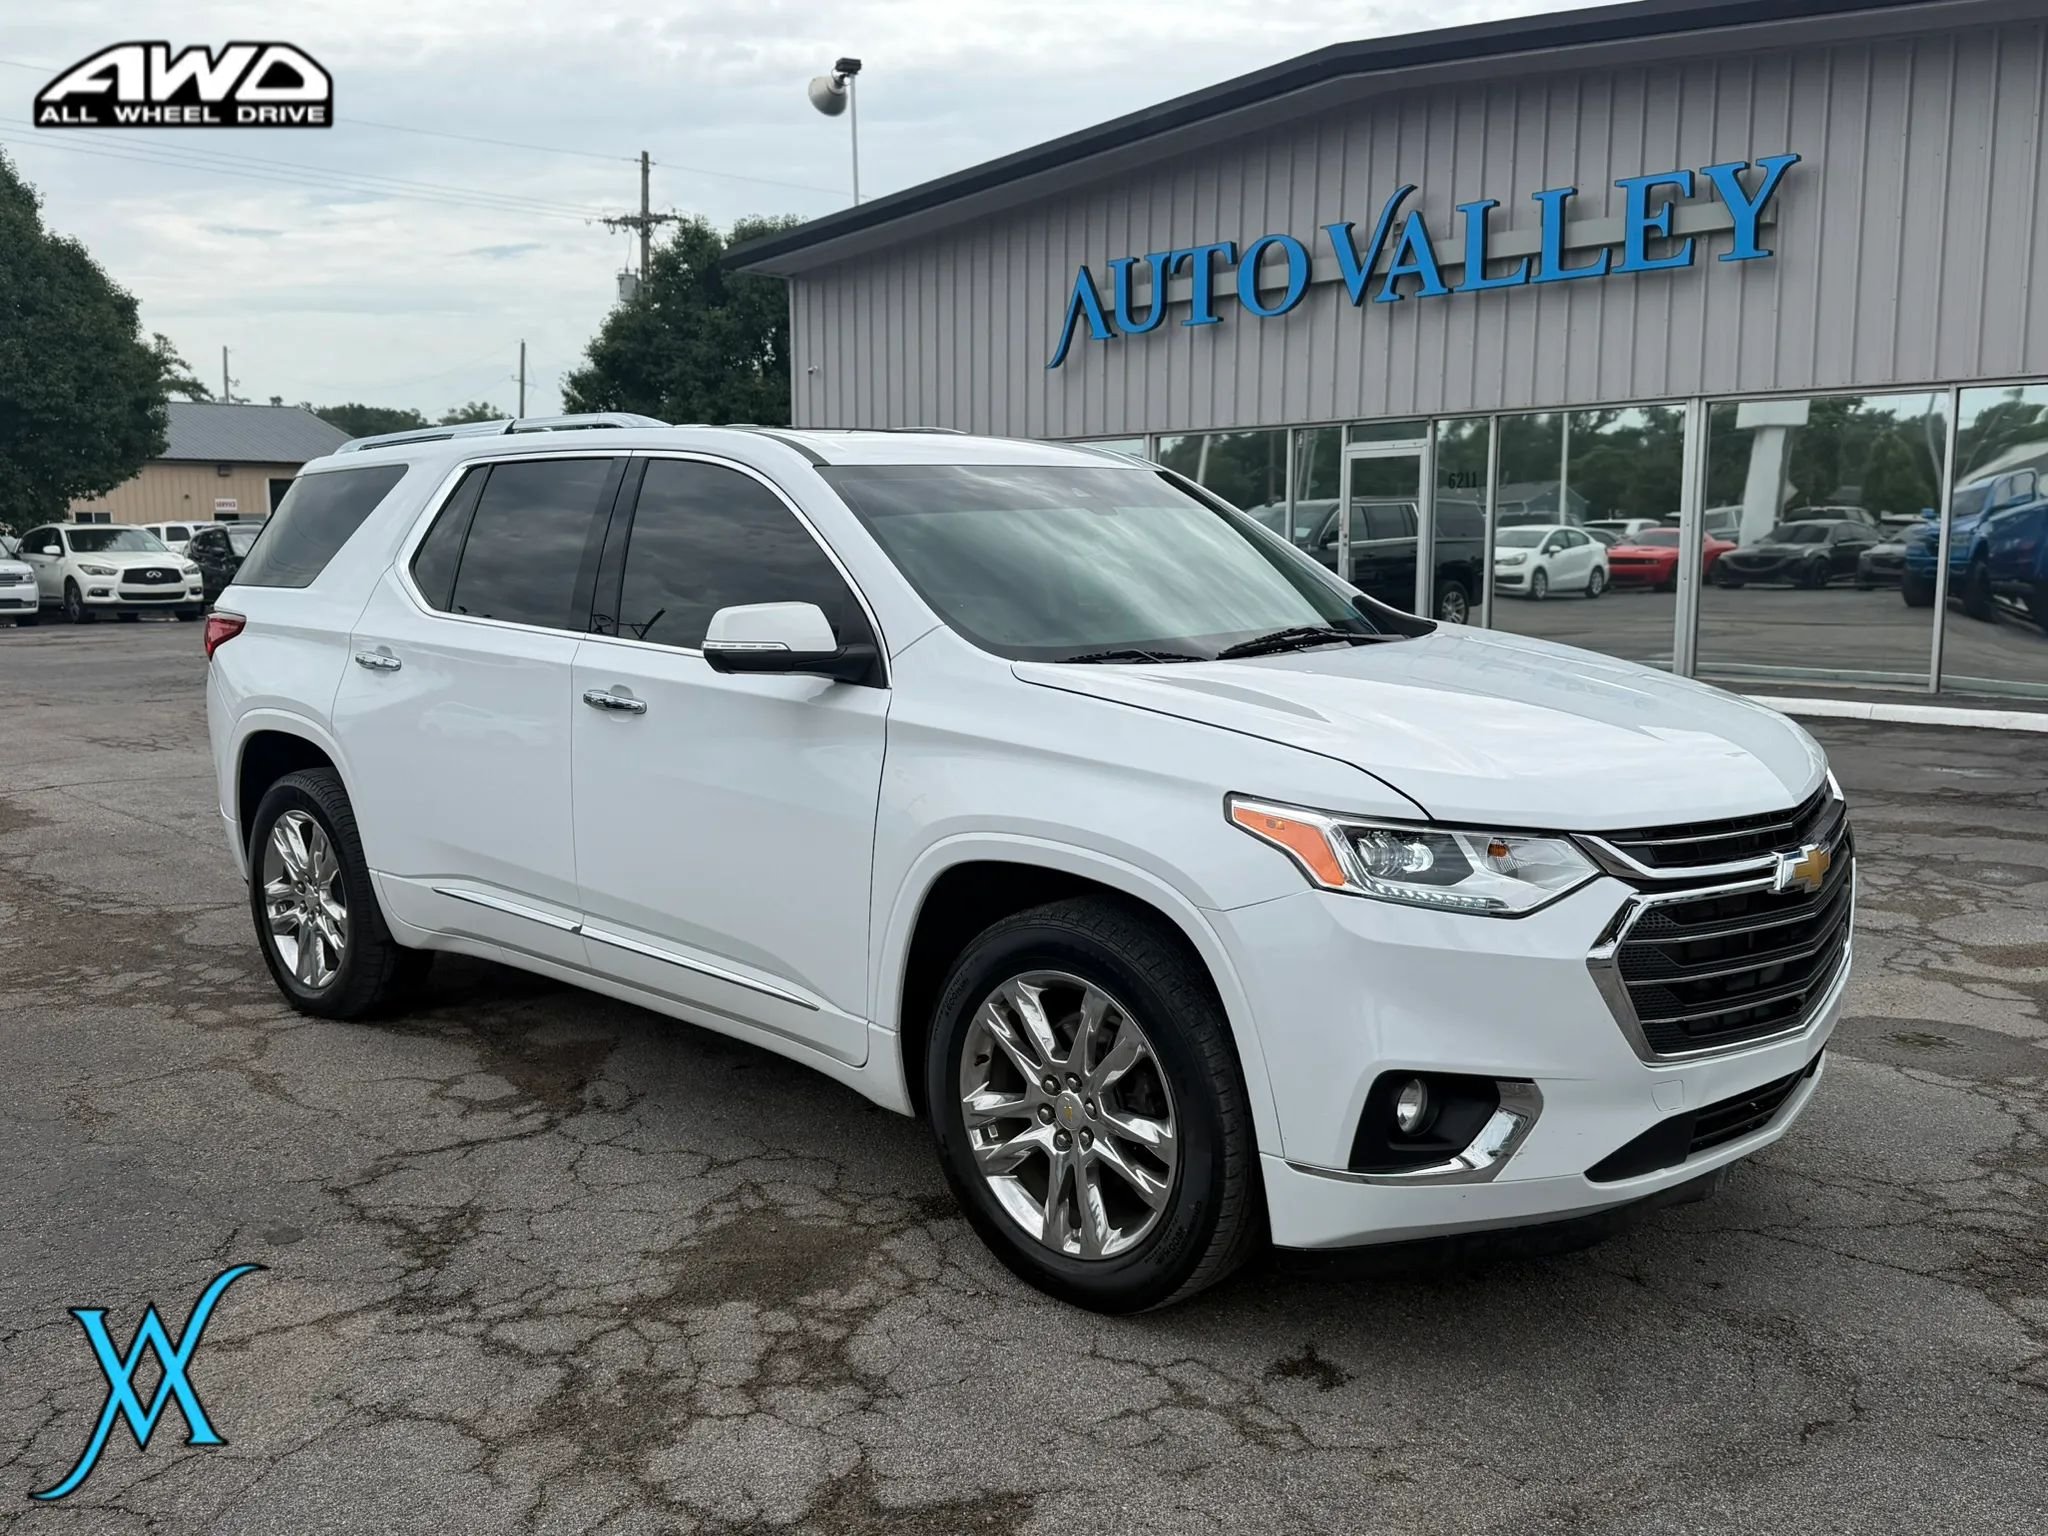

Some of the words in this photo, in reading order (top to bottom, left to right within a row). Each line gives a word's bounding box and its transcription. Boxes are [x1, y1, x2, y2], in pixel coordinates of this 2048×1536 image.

[1045, 233, 1312, 370] AUTO
[1320, 153, 1801, 307] VALLEY
[1448, 471, 1477, 489] 6211
